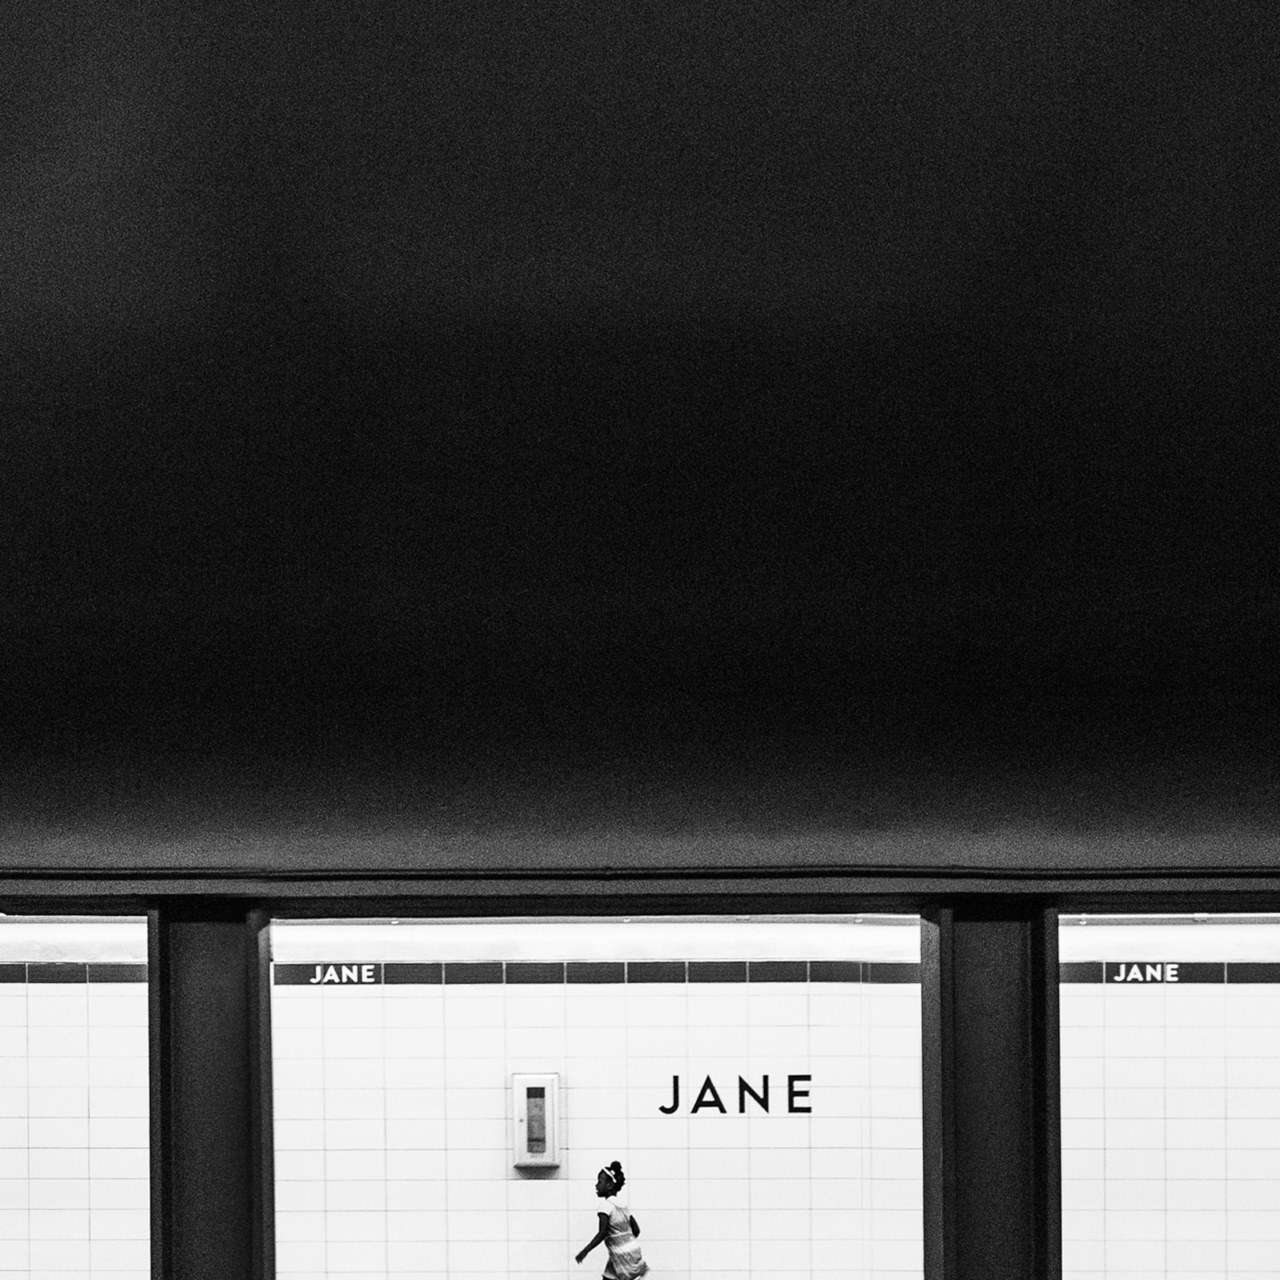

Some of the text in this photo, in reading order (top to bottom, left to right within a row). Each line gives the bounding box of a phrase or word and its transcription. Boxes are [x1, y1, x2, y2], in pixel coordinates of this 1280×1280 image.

[309, 964, 376, 983] JANE
[1113, 963, 1179, 982] JANE
[659, 1075, 812, 1115] JANE
